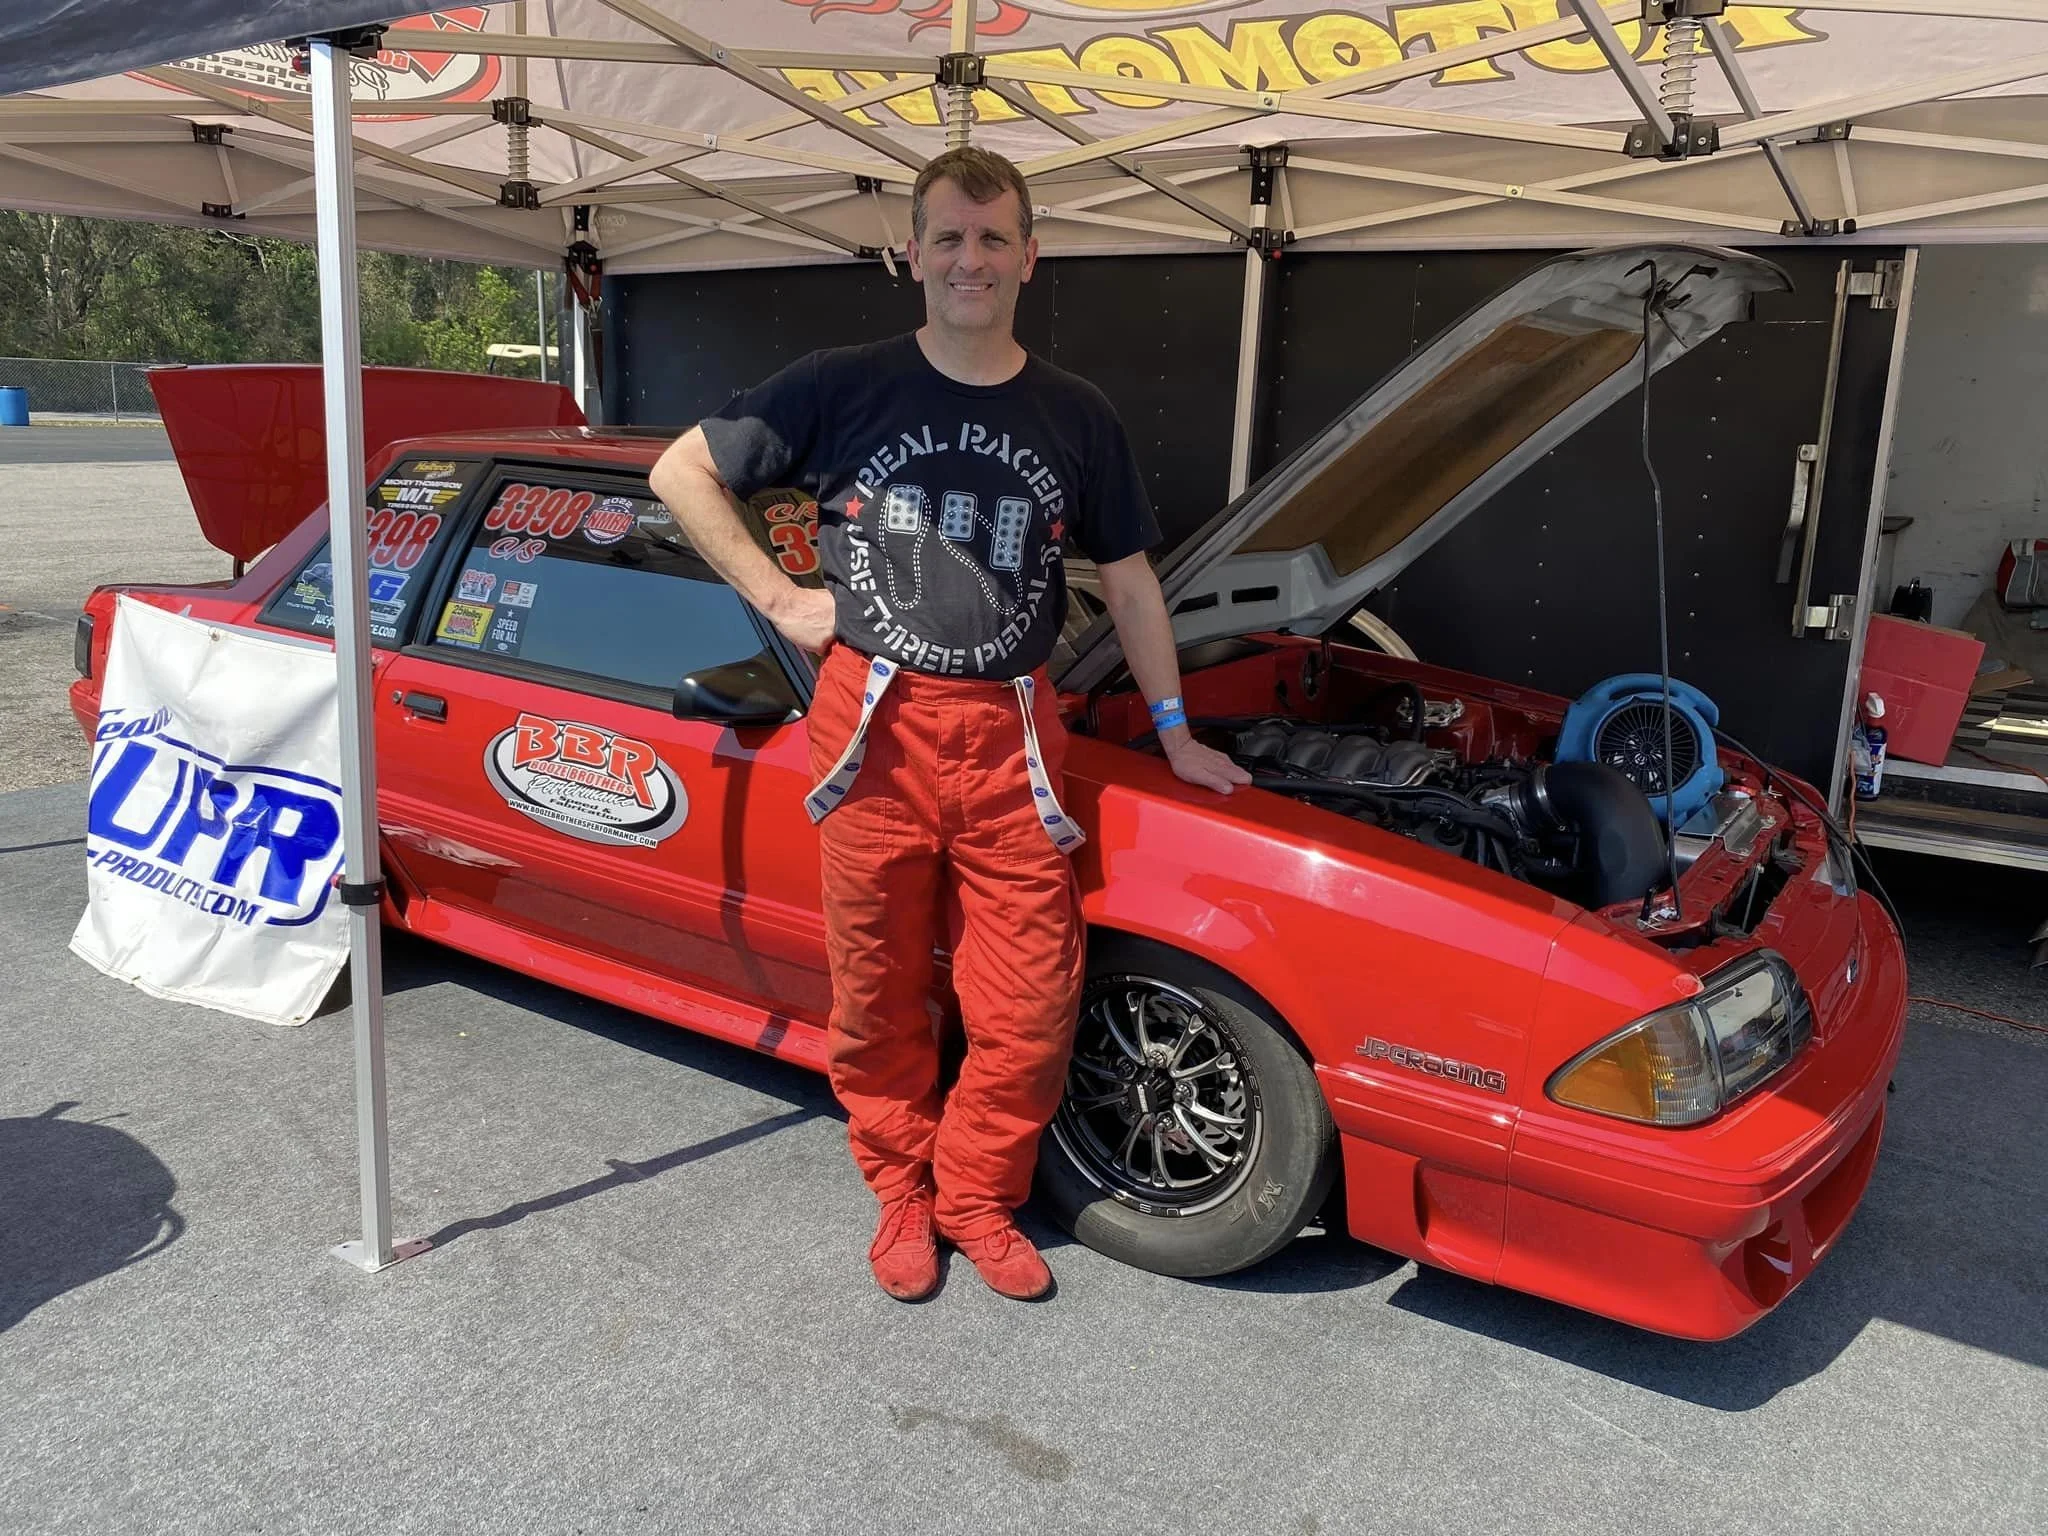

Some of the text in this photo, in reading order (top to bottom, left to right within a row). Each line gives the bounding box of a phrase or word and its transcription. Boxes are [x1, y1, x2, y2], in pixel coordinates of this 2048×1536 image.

[855, 424, 949, 499] REAL
[396, 487, 441, 503] M/T
[414, 480, 462, 489] THOMPSON
[484, 483, 595, 539] 3398
[584, 509, 635, 533] NMRA
[602, 497, 633, 509] 2022
[366, 506, 442, 571] 398
[489, 536, 547, 563] C/S
[846, 523, 1062, 675] USE THREE PEDALS
[491, 629, 506, 641] FOR
[506, 632, 518, 644] ALL
[497, 618, 519, 632] SPEED
[96, 705, 175, 742] Team
[512, 711, 658, 811] BBR
[529, 760, 634, 796] BOOZE BROTHERS
[88, 740, 341, 907] UPR
[509, 800, 657, 848] WWW.BOOZEBROTHERSPERFORMANCE.COM
